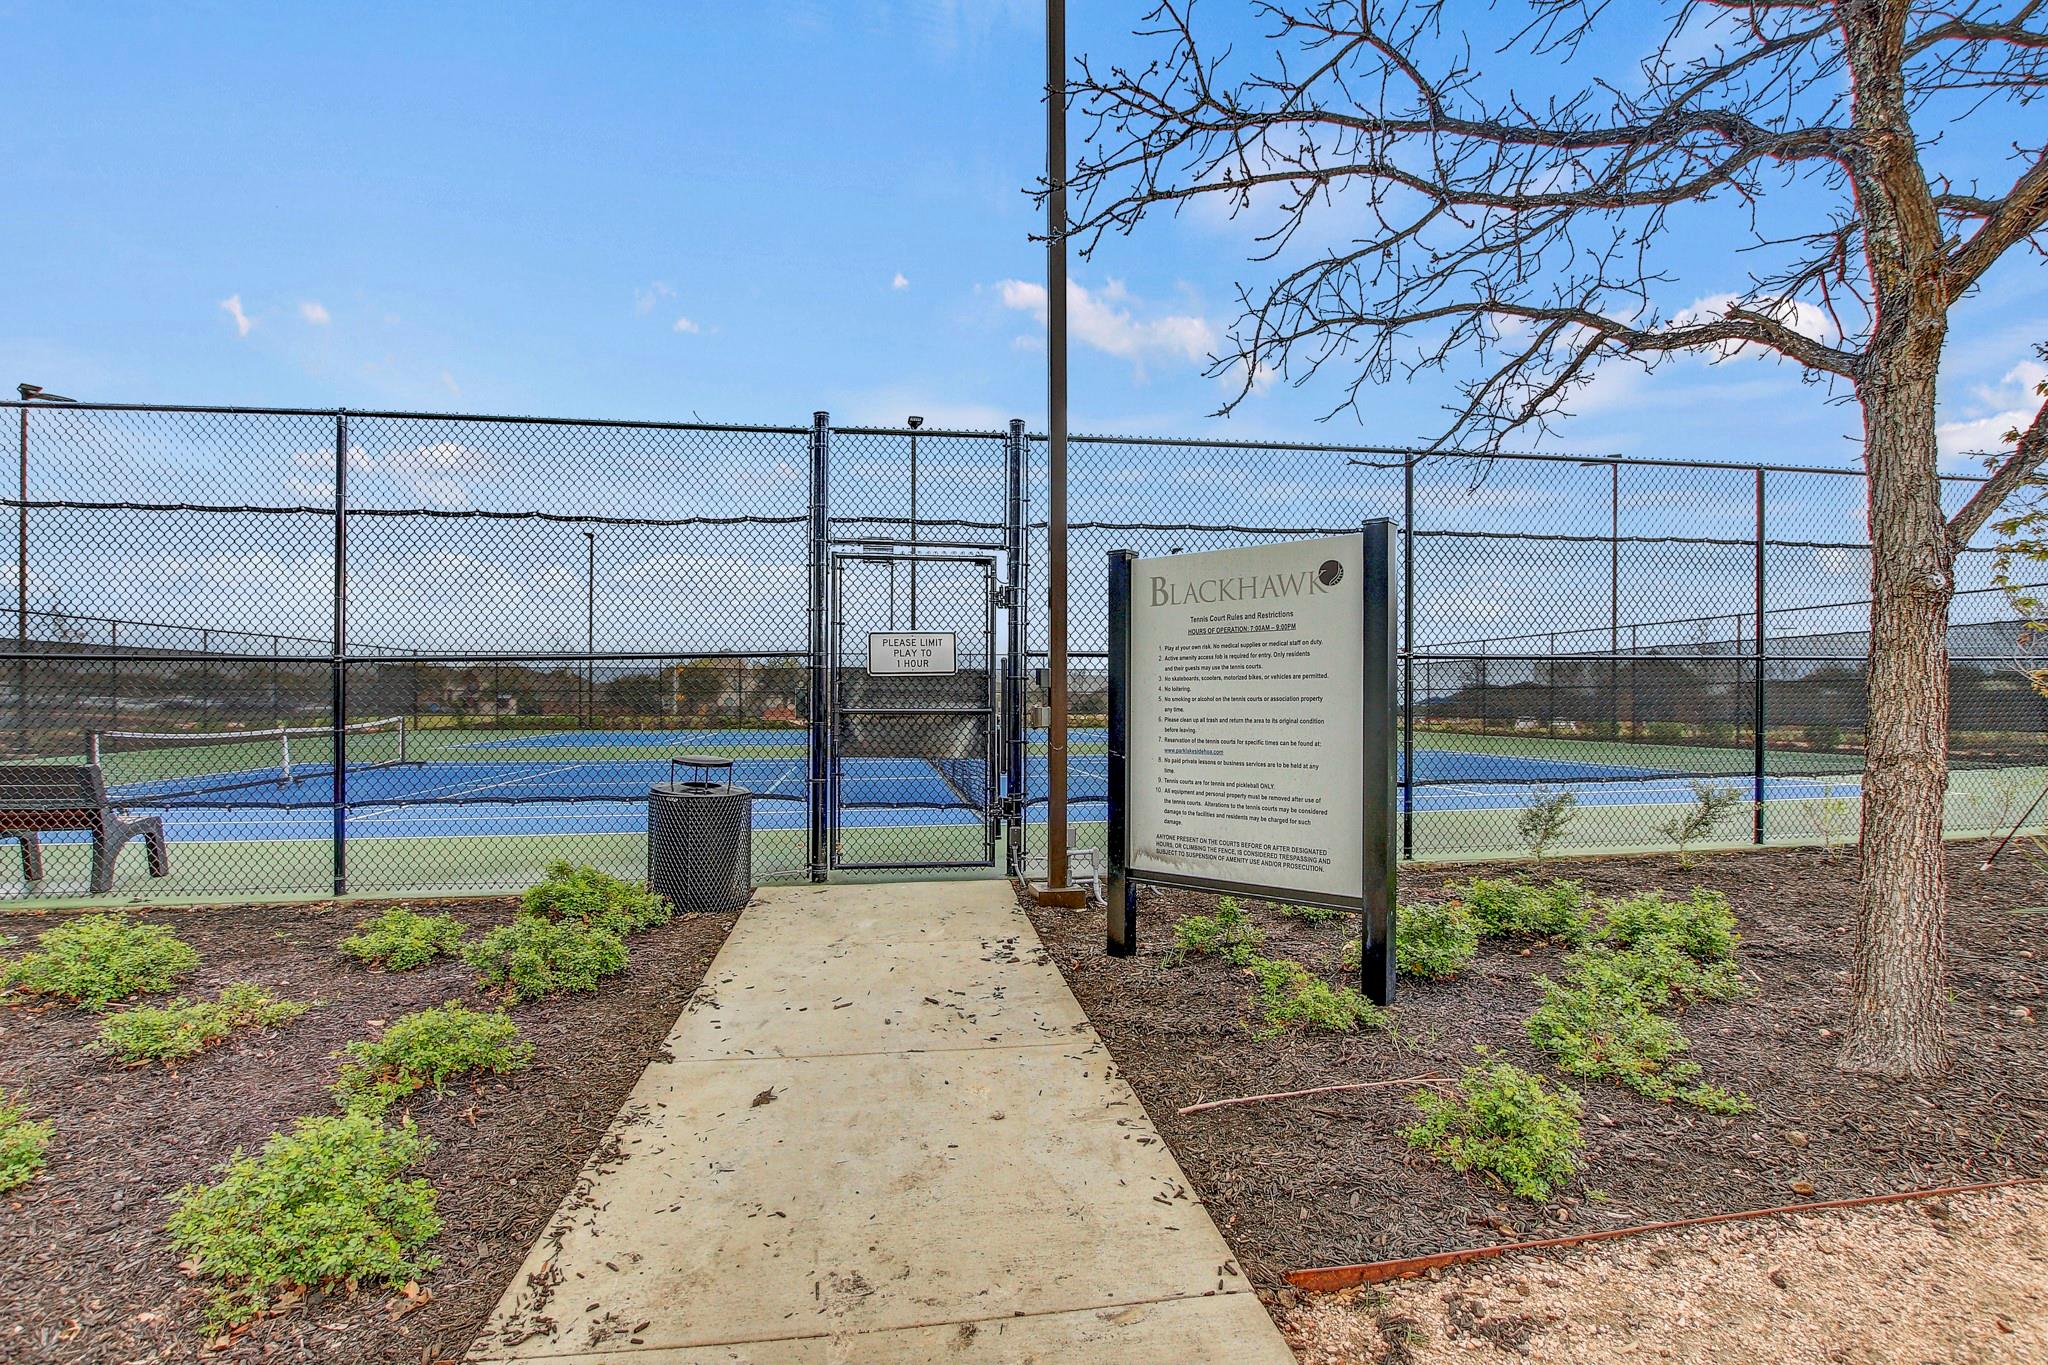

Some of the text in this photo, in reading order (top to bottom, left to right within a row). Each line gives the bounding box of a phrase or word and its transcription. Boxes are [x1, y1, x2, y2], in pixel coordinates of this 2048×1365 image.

[1257, 611, 1293, 619] Restrictions
[1216, 627, 1249, 635] OPERATION:
[1275, 624, 1296, 632] 9:00PM
[882, 639, 943, 647] PLEASE LIMIT
[1164, 645, 1174, 653] Play
[1240, 642, 1260, 650] supplies
[893, 649, 932, 657] PLAY TO
[1179, 655, 1197, 663] amenity
[1229, 653, 1249, 661] required
[1273, 652, 1285, 660] Only
[897, 660, 929, 668] 1 HOUR
[1185, 665, 1200, 673] guests
[1279, 718, 1299, 726] original
[1245, 739, 1264, 747] specific
[1182, 758, 1197, 766] private
[1236, 782, 1259, 790] pickleball
[1171, 789, 1195, 797] equipment
[1205, 791, 1226, 800] personal
[1226, 793, 1247, 801] property
[1204, 801, 1230, 809] Alterations
[1298, 808, 1328, 816] considered
[1164, 809, 1181, 817] damage
[1268, 816, 1288, 825] charged
[1164, 819, 1182, 827] damage.
[1176, 835, 1199, 843] PRESENT
[1219, 839, 1240, 847] COURTS
[1241, 841, 1263, 849] BEFORE
[1272, 844, 1290, 852] AFTER
[1291, 846, 1327, 856] DESIGNATED
[1156, 841, 1174, 849] HOURS,
[1182, 844, 1207, 852] CLIMBING
[1218, 847, 1236, 855] FENCE,
[1243, 850, 1278, 859] CONSIDERED
[1279, 853, 1318, 863] TRESPASSING
[1156, 849, 1178, 857] SUBJECT
[1186, 852, 1217, 861] SUSPENSION
[1226, 856, 1248, 864] AMENITY
[1261, 860, 1282, 868] AND/OR
[1282, 863, 1324, 873] PROSECUTION.
